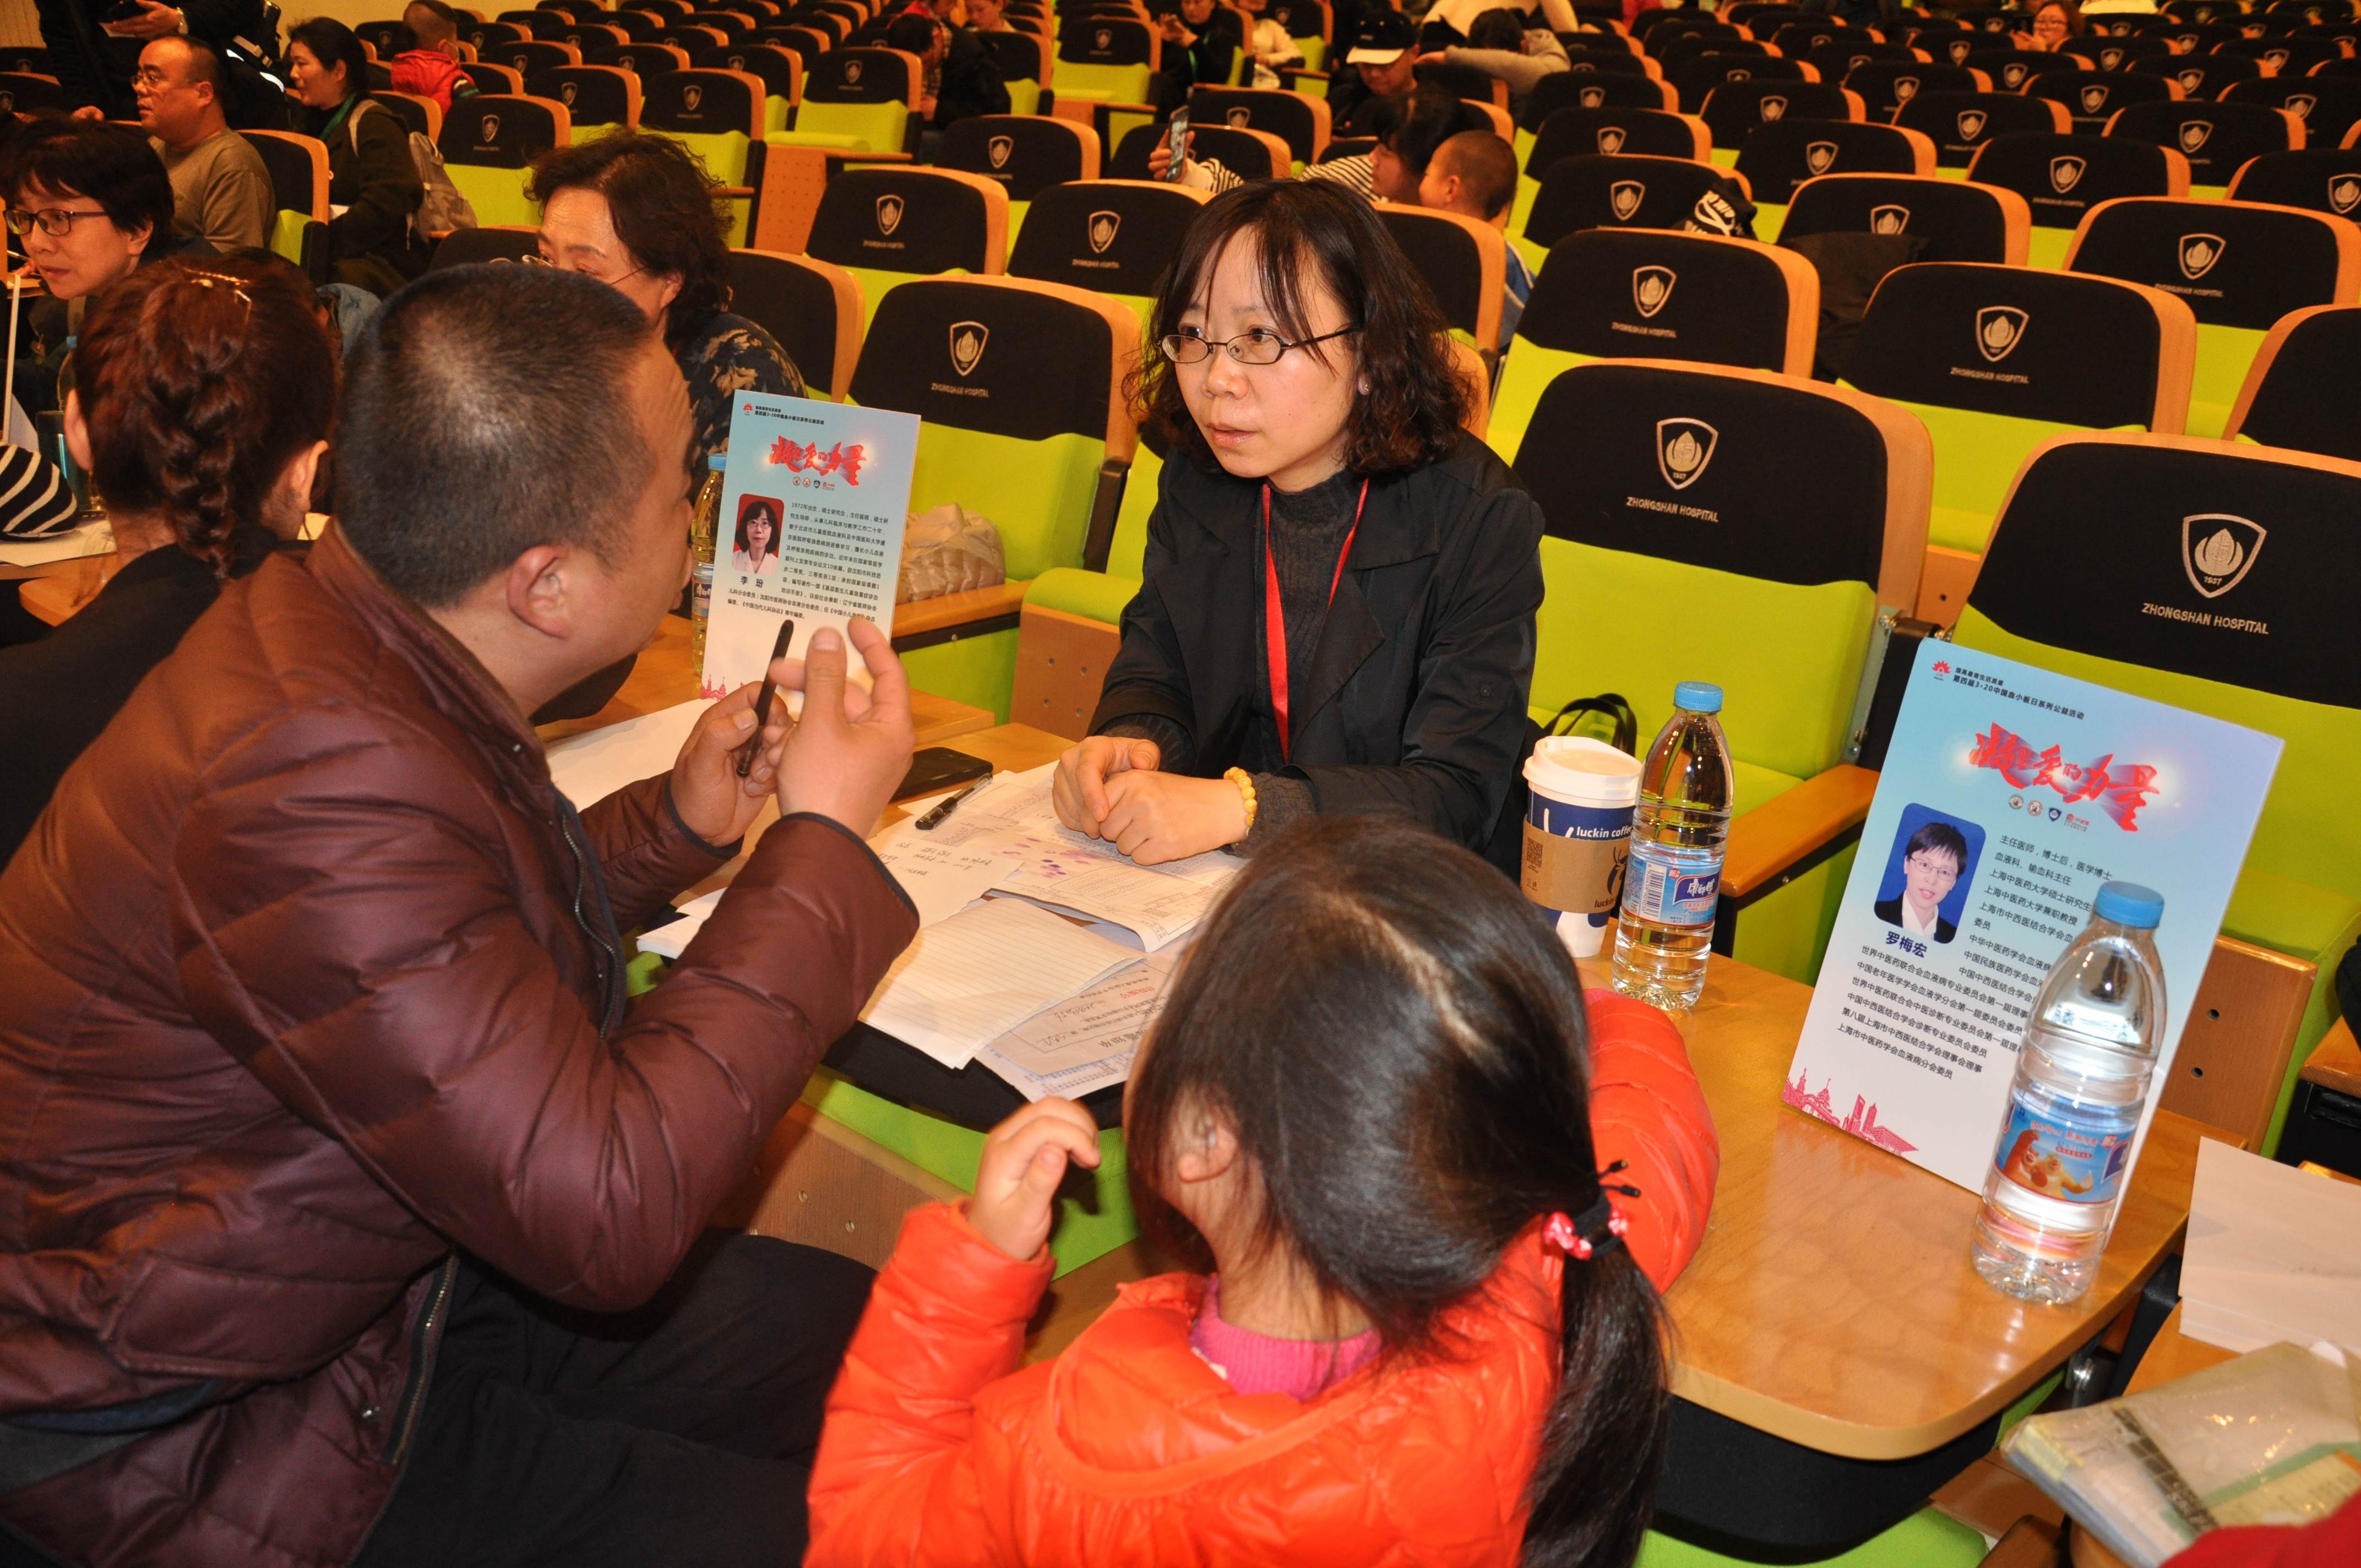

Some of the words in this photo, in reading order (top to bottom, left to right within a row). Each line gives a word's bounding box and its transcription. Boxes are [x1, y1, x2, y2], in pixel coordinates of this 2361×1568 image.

[1626, 497, 1679, 514] ZHONGSHAN
[1679, 505, 1718, 522] HOSPITAL
[2141, 603, 2212, 625] ZHONGSHAN
[2213, 616, 2269, 634] HOSPITAL
[1576, 826, 1609, 838] luckin
[1995, 852, 2072, 885] 血液科、输血科主任
[2000, 835, 2113, 881] 主任医师，博士后，医学博士
[1687, 878, 1715, 897] 康师傅
[1984, 885, 2079, 927] 上海中医药大学兼职教授
[1973, 917, 1991, 931] 委员
[1885, 930, 1928, 959] 罗梅宏
[1856, 961, 2023, 1036] 中国老年医学学会血液学分会第一届委员会委员
[1959, 967, 2036, 1004] 中国中西医结合学会
[1841, 1006, 1983, 1074] 第八届上海市中西医结合学会理事会理事
[1847, 992, 1987, 1058] 中国中西医结合学会诊断专业委员会委员
[1837, 1023, 1952, 1079] 上海市中医药学会血液病分会委员
